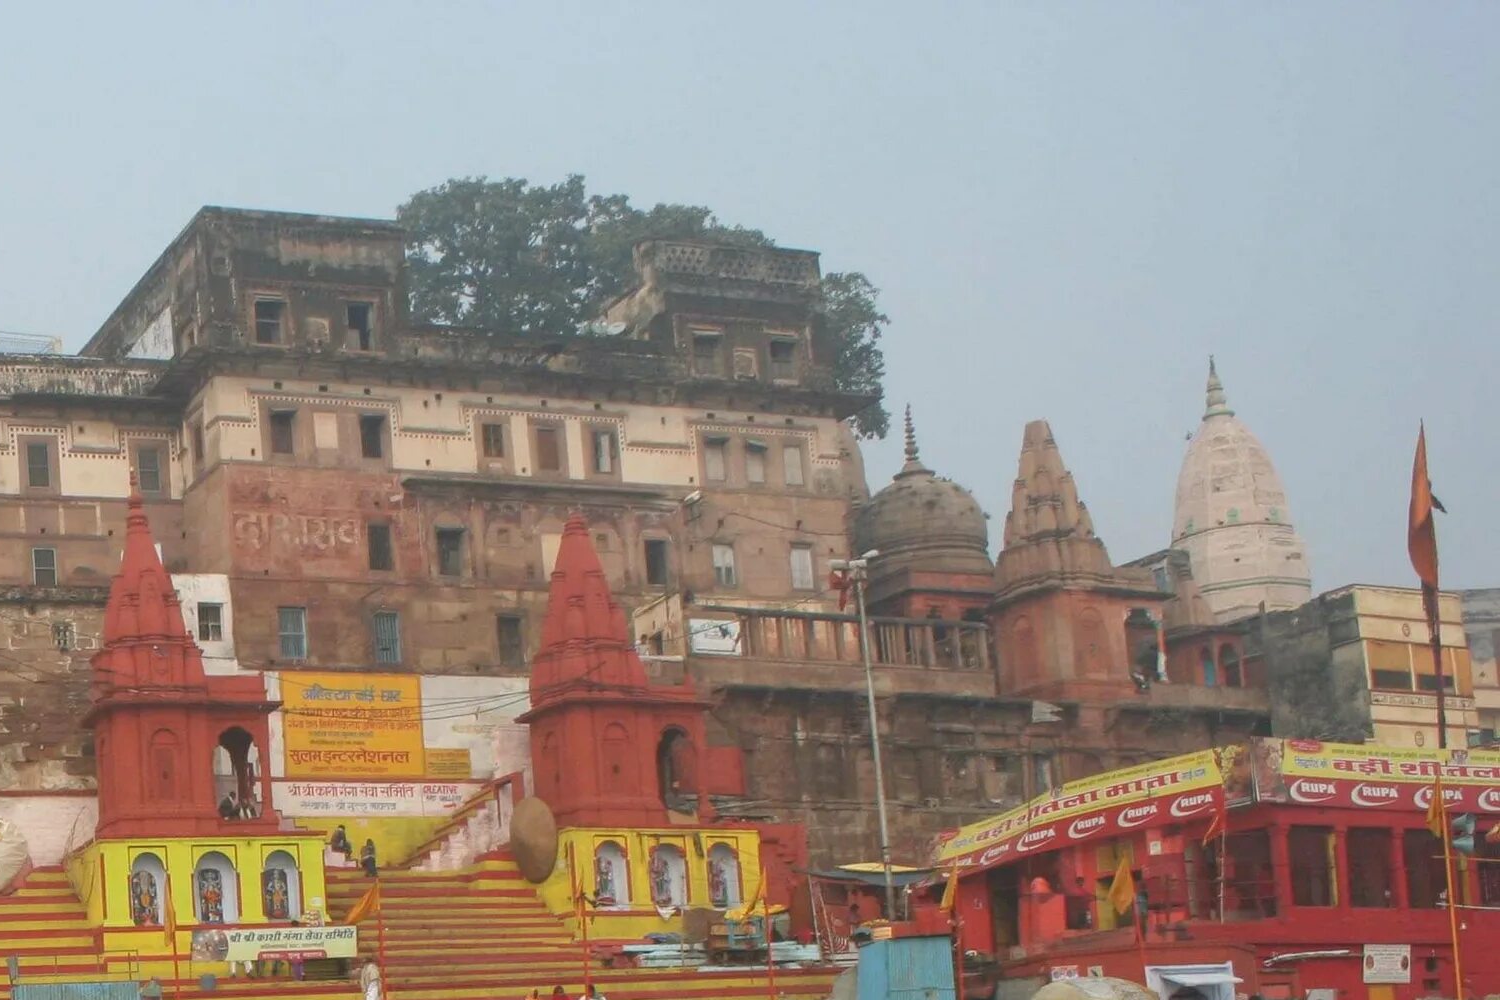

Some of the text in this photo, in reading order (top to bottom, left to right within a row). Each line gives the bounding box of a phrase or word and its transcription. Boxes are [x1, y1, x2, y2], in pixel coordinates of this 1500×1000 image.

[1332, 758, 1394, 776] बड़ी
[422, 785, 459, 794] CREATIVE
[1102, 771, 1180, 798] माता
[1301, 781, 1337, 795] RUPA
[1362, 786, 1399, 798] RUPA
[1180, 793, 1213, 808] RUPA
[1127, 804, 1158, 818] RUPA
[1076, 815, 1106, 832] RUPA
[1024, 827, 1056, 844] RUPA
[229, 928, 355, 943] श्री श्री काशी गंगा सेवा समिति
